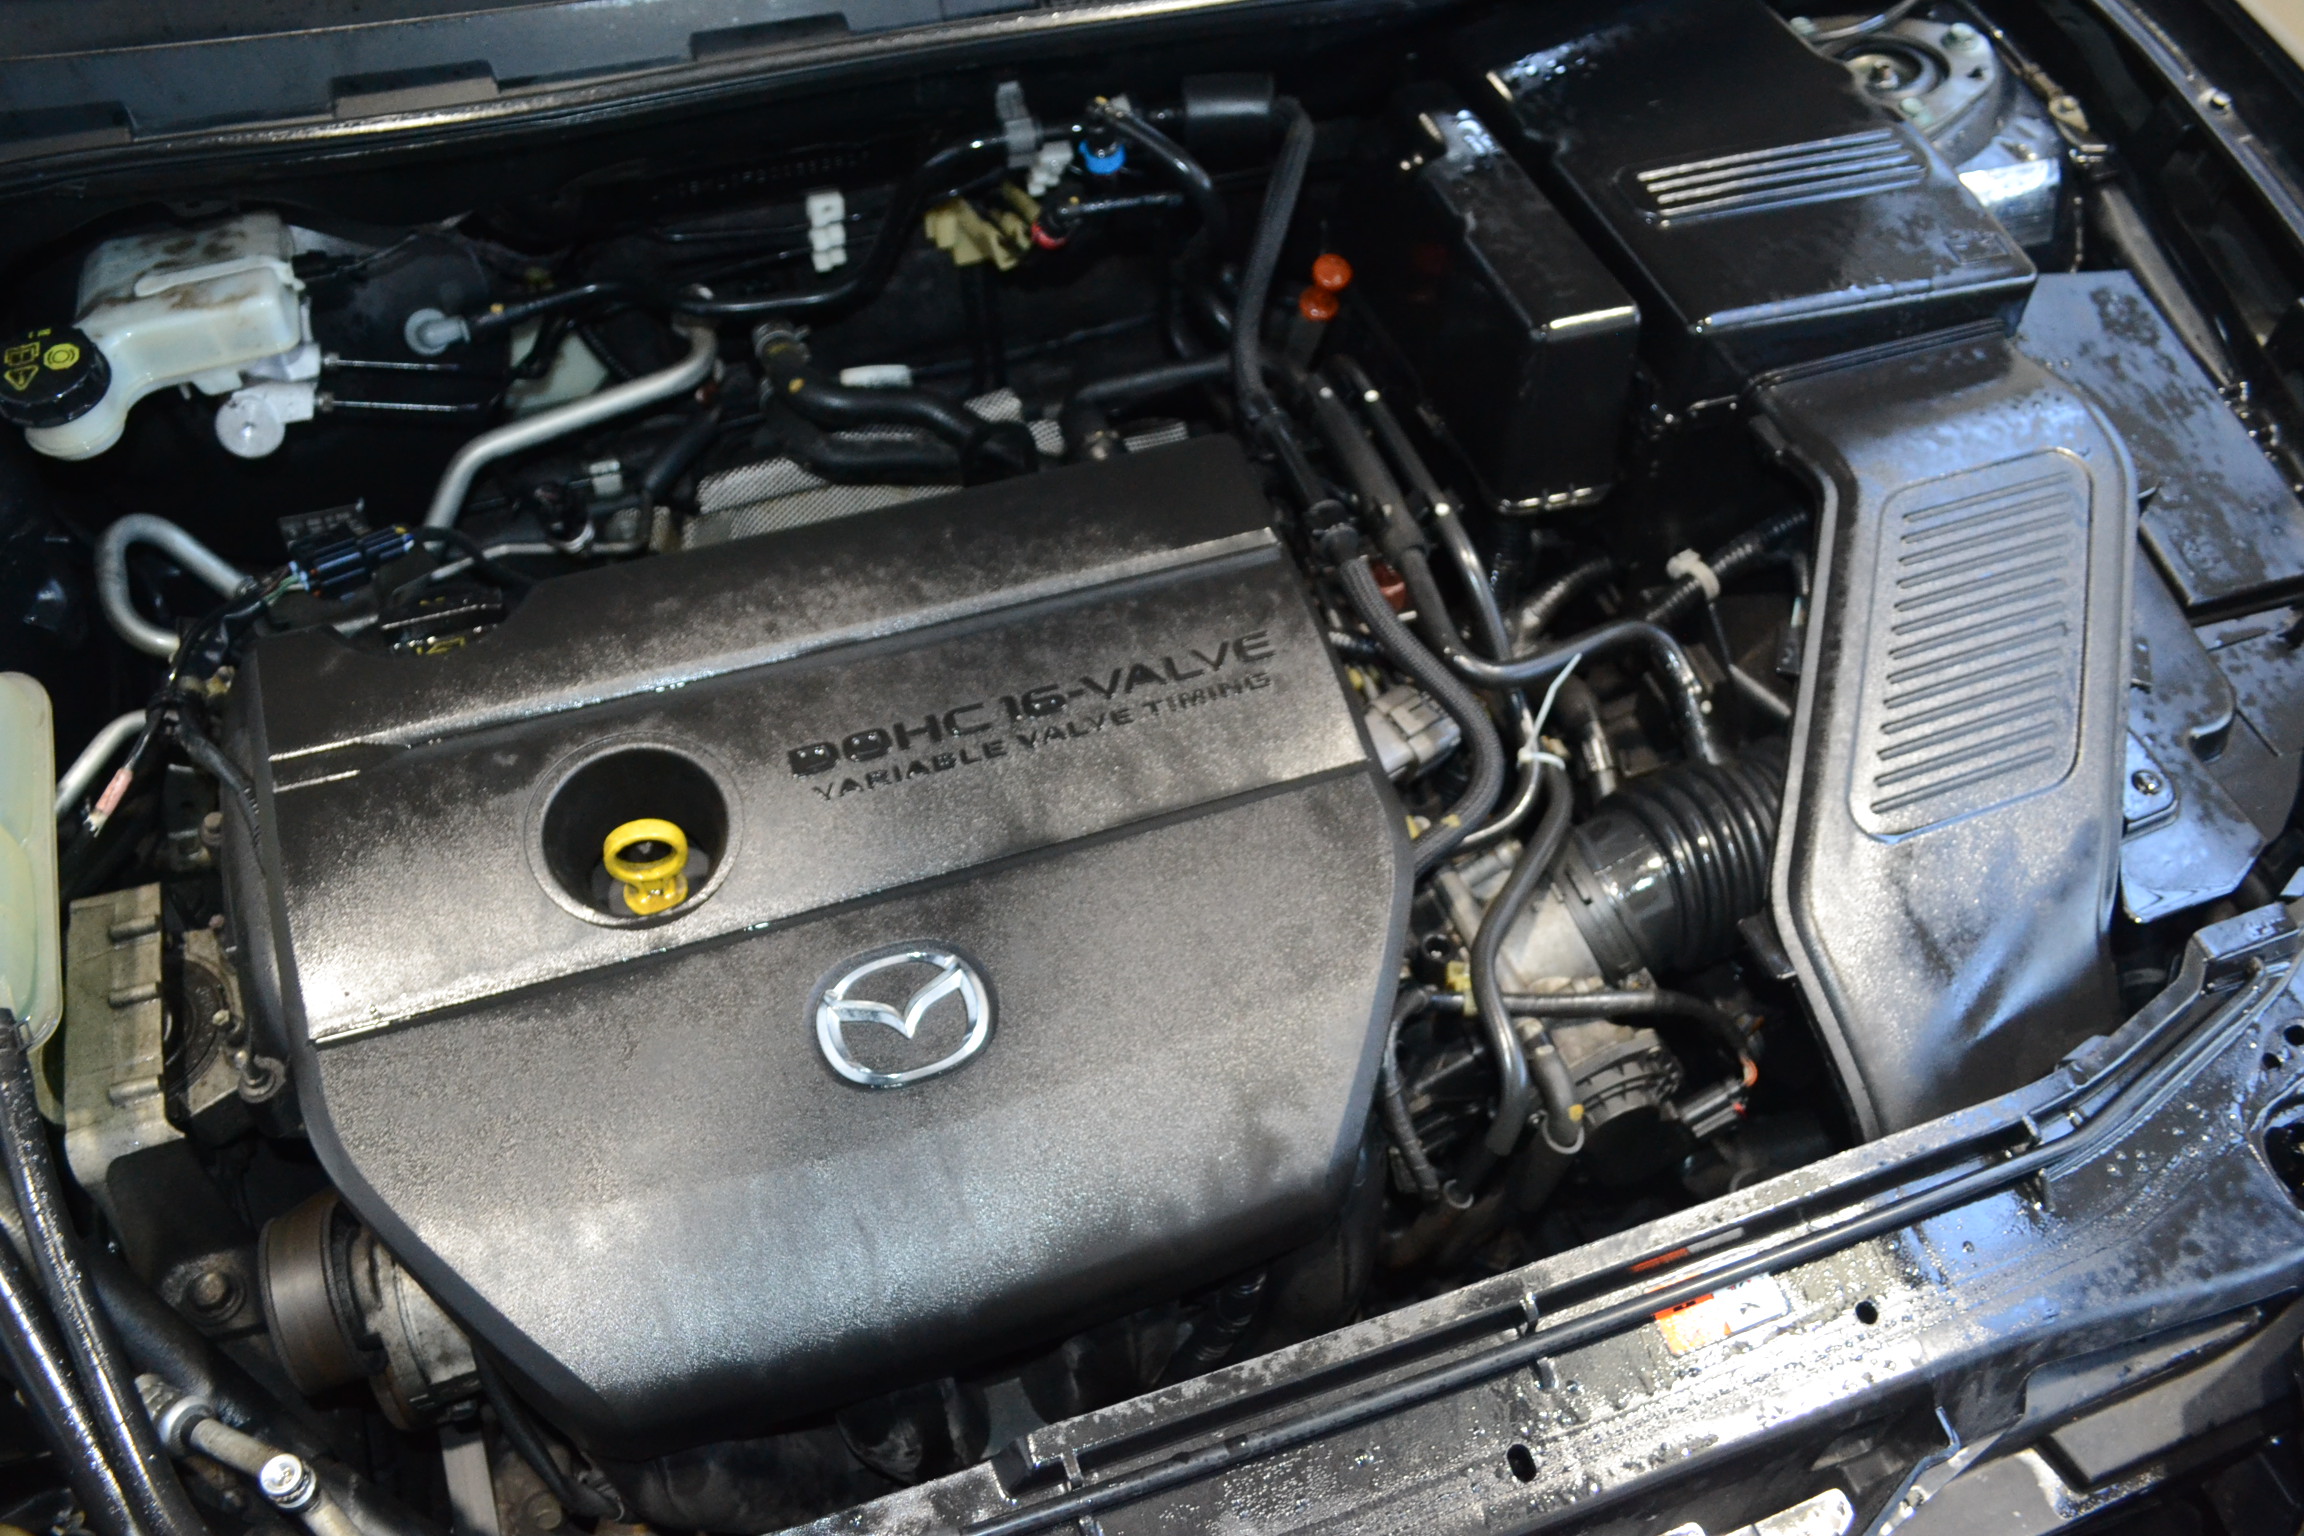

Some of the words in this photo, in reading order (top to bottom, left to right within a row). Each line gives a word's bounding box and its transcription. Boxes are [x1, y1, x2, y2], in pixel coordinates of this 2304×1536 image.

[788, 703, 993, 778] DOHC
[999, 629, 1276, 721] 16-VALVE
[813, 738, 1007, 801] VARIABLE
[1015, 706, 1135, 749] VALVE
[1142, 671, 1273, 716] TIMING
